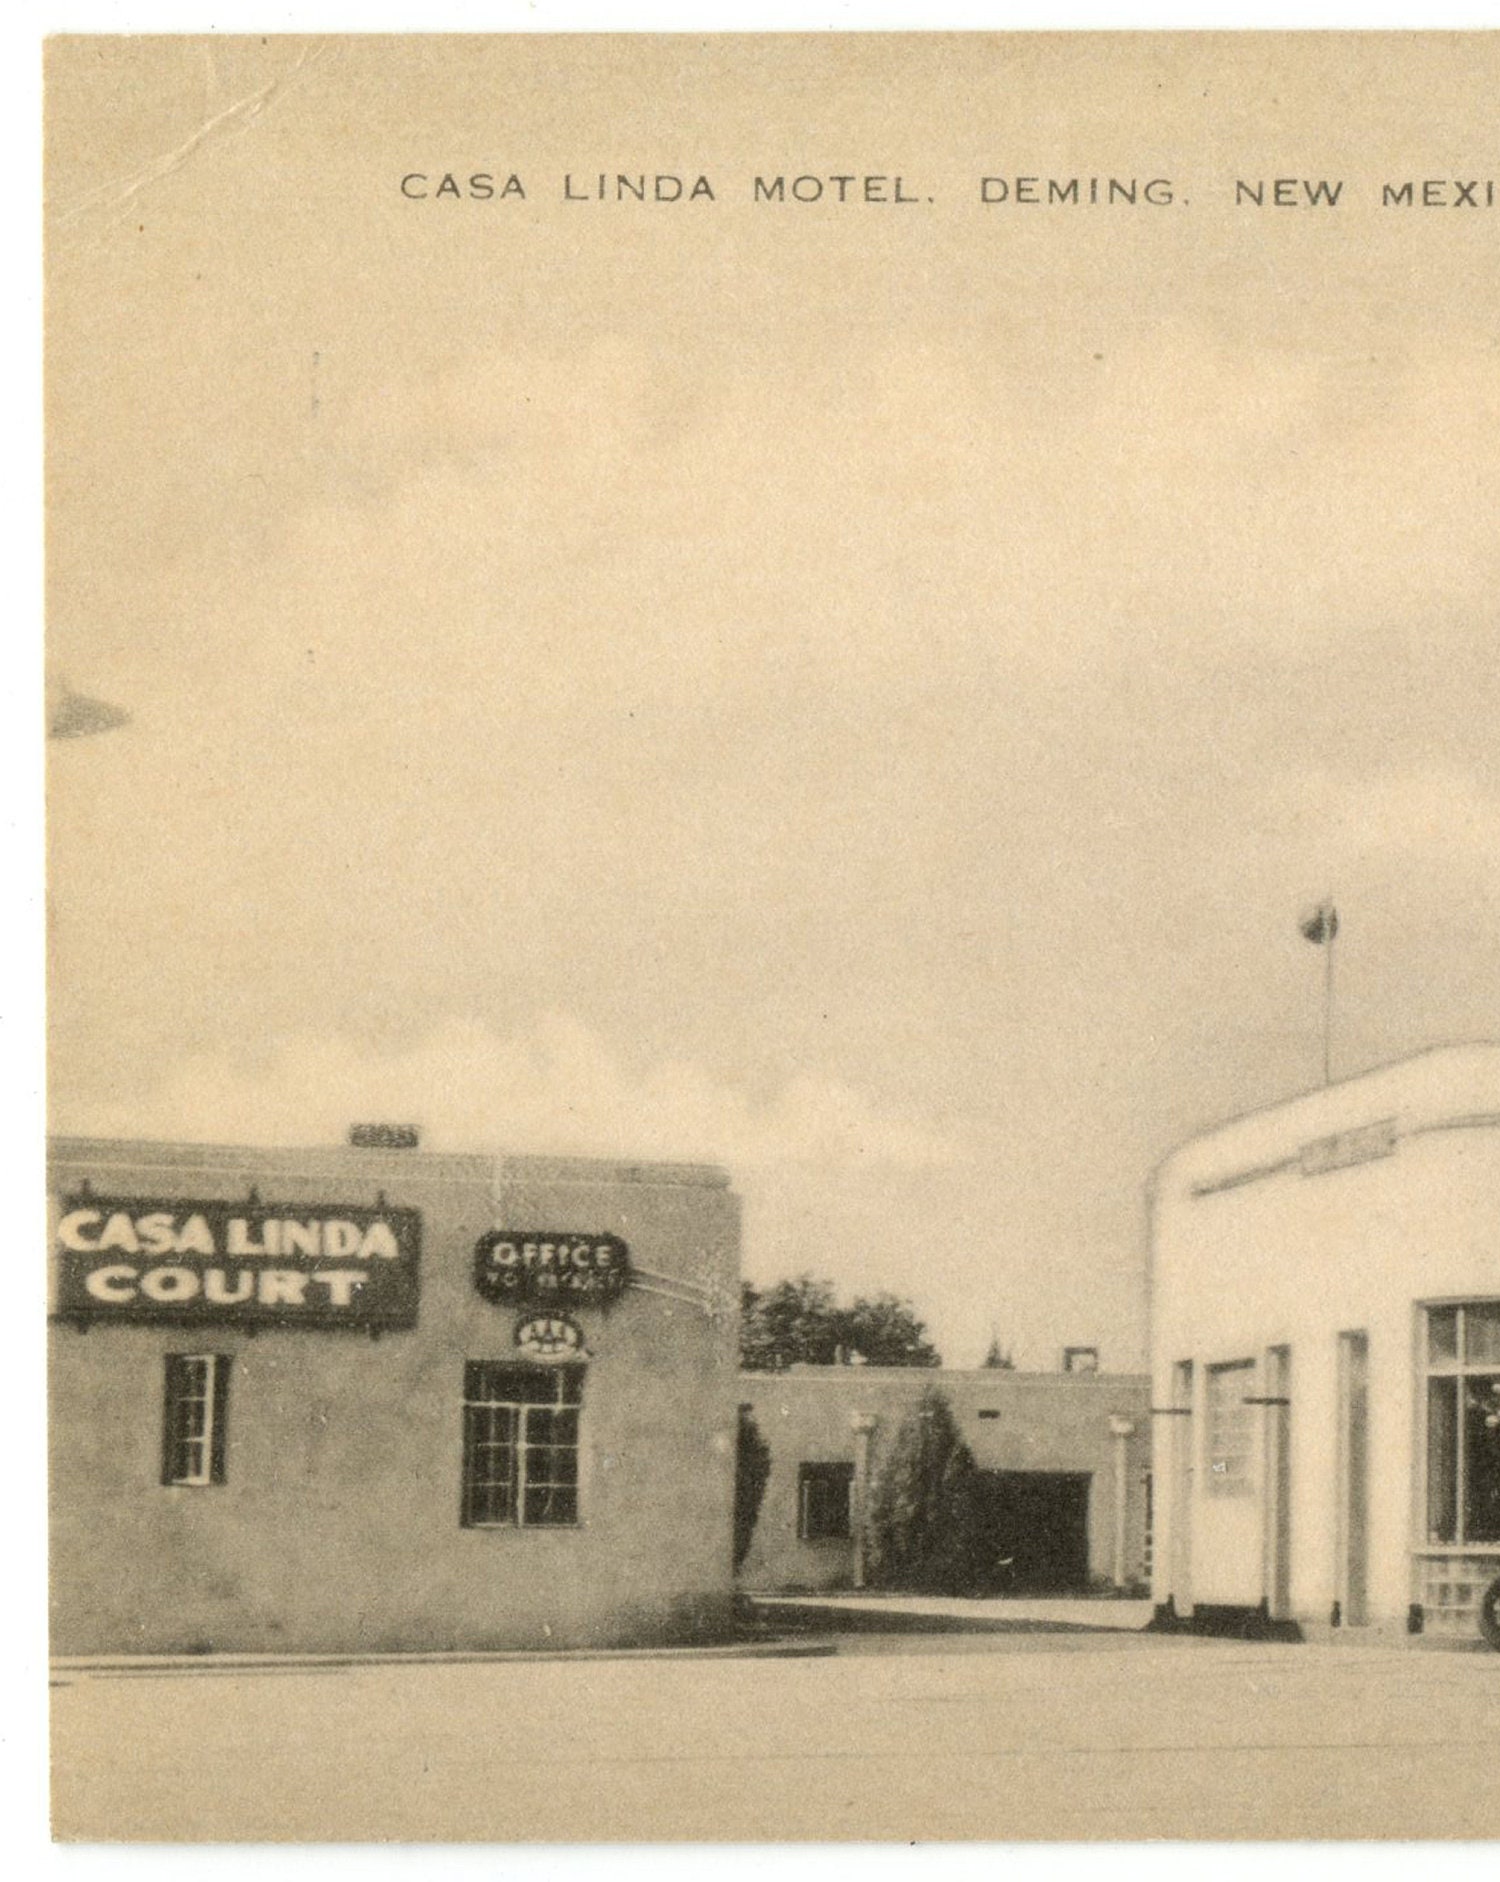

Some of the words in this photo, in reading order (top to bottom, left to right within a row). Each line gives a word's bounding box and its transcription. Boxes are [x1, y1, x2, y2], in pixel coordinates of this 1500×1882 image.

[57, 1208, 216, 1255] CASA
[226, 1218, 400, 1259] LINDA
[492, 1241, 612, 1268] OFFICE
[84, 1263, 369, 1306] COURT
